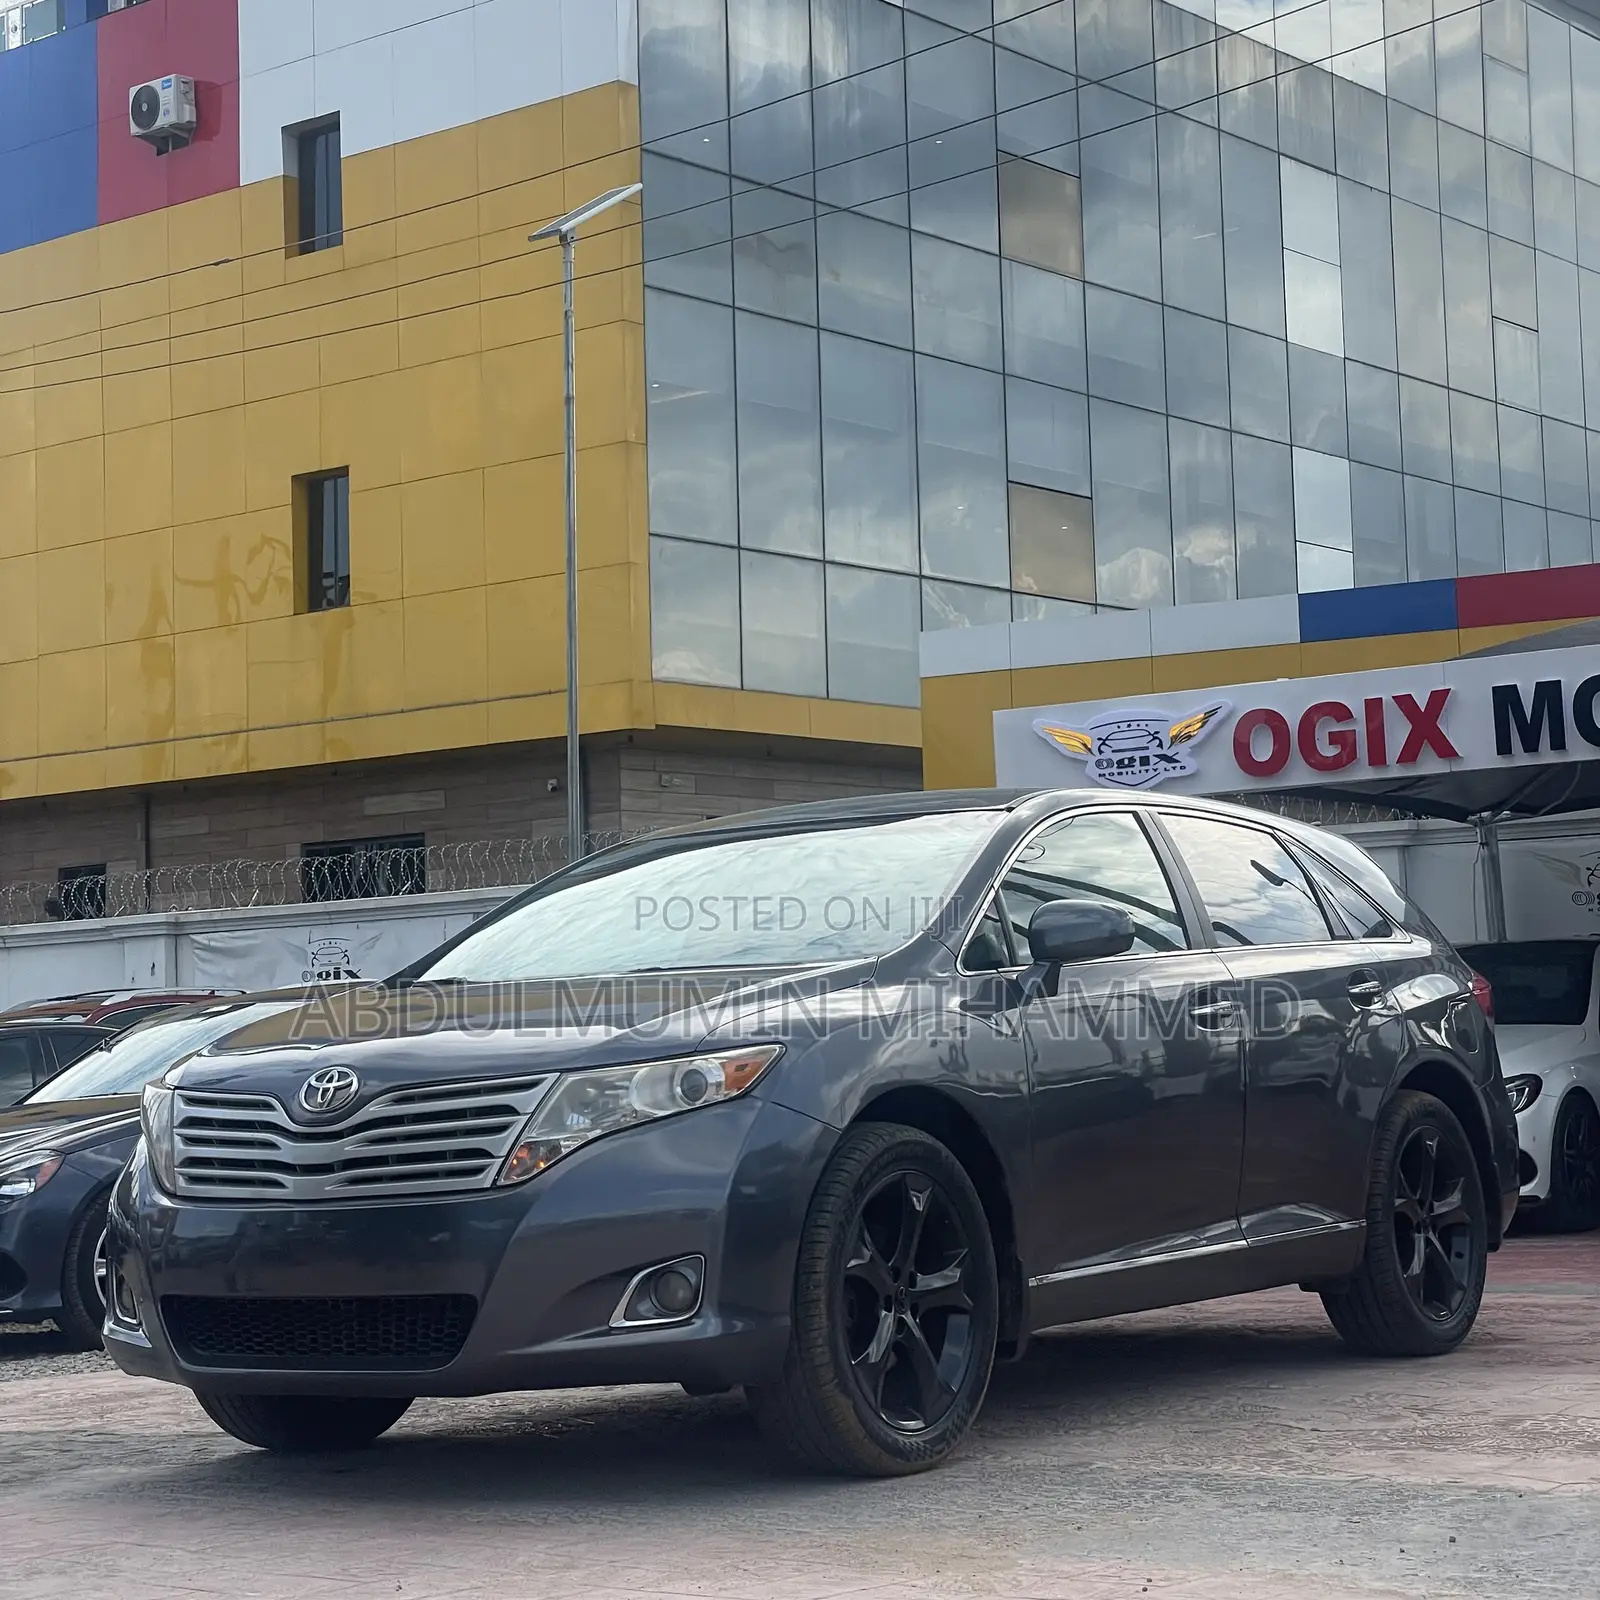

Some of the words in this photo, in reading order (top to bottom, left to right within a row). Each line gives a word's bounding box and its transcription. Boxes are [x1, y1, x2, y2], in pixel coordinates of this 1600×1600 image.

[1232, 687, 1463, 778] OGIX
[1098, 767, 1159, 778] MOBILITY
[1163, 765, 1187, 773] LTD
